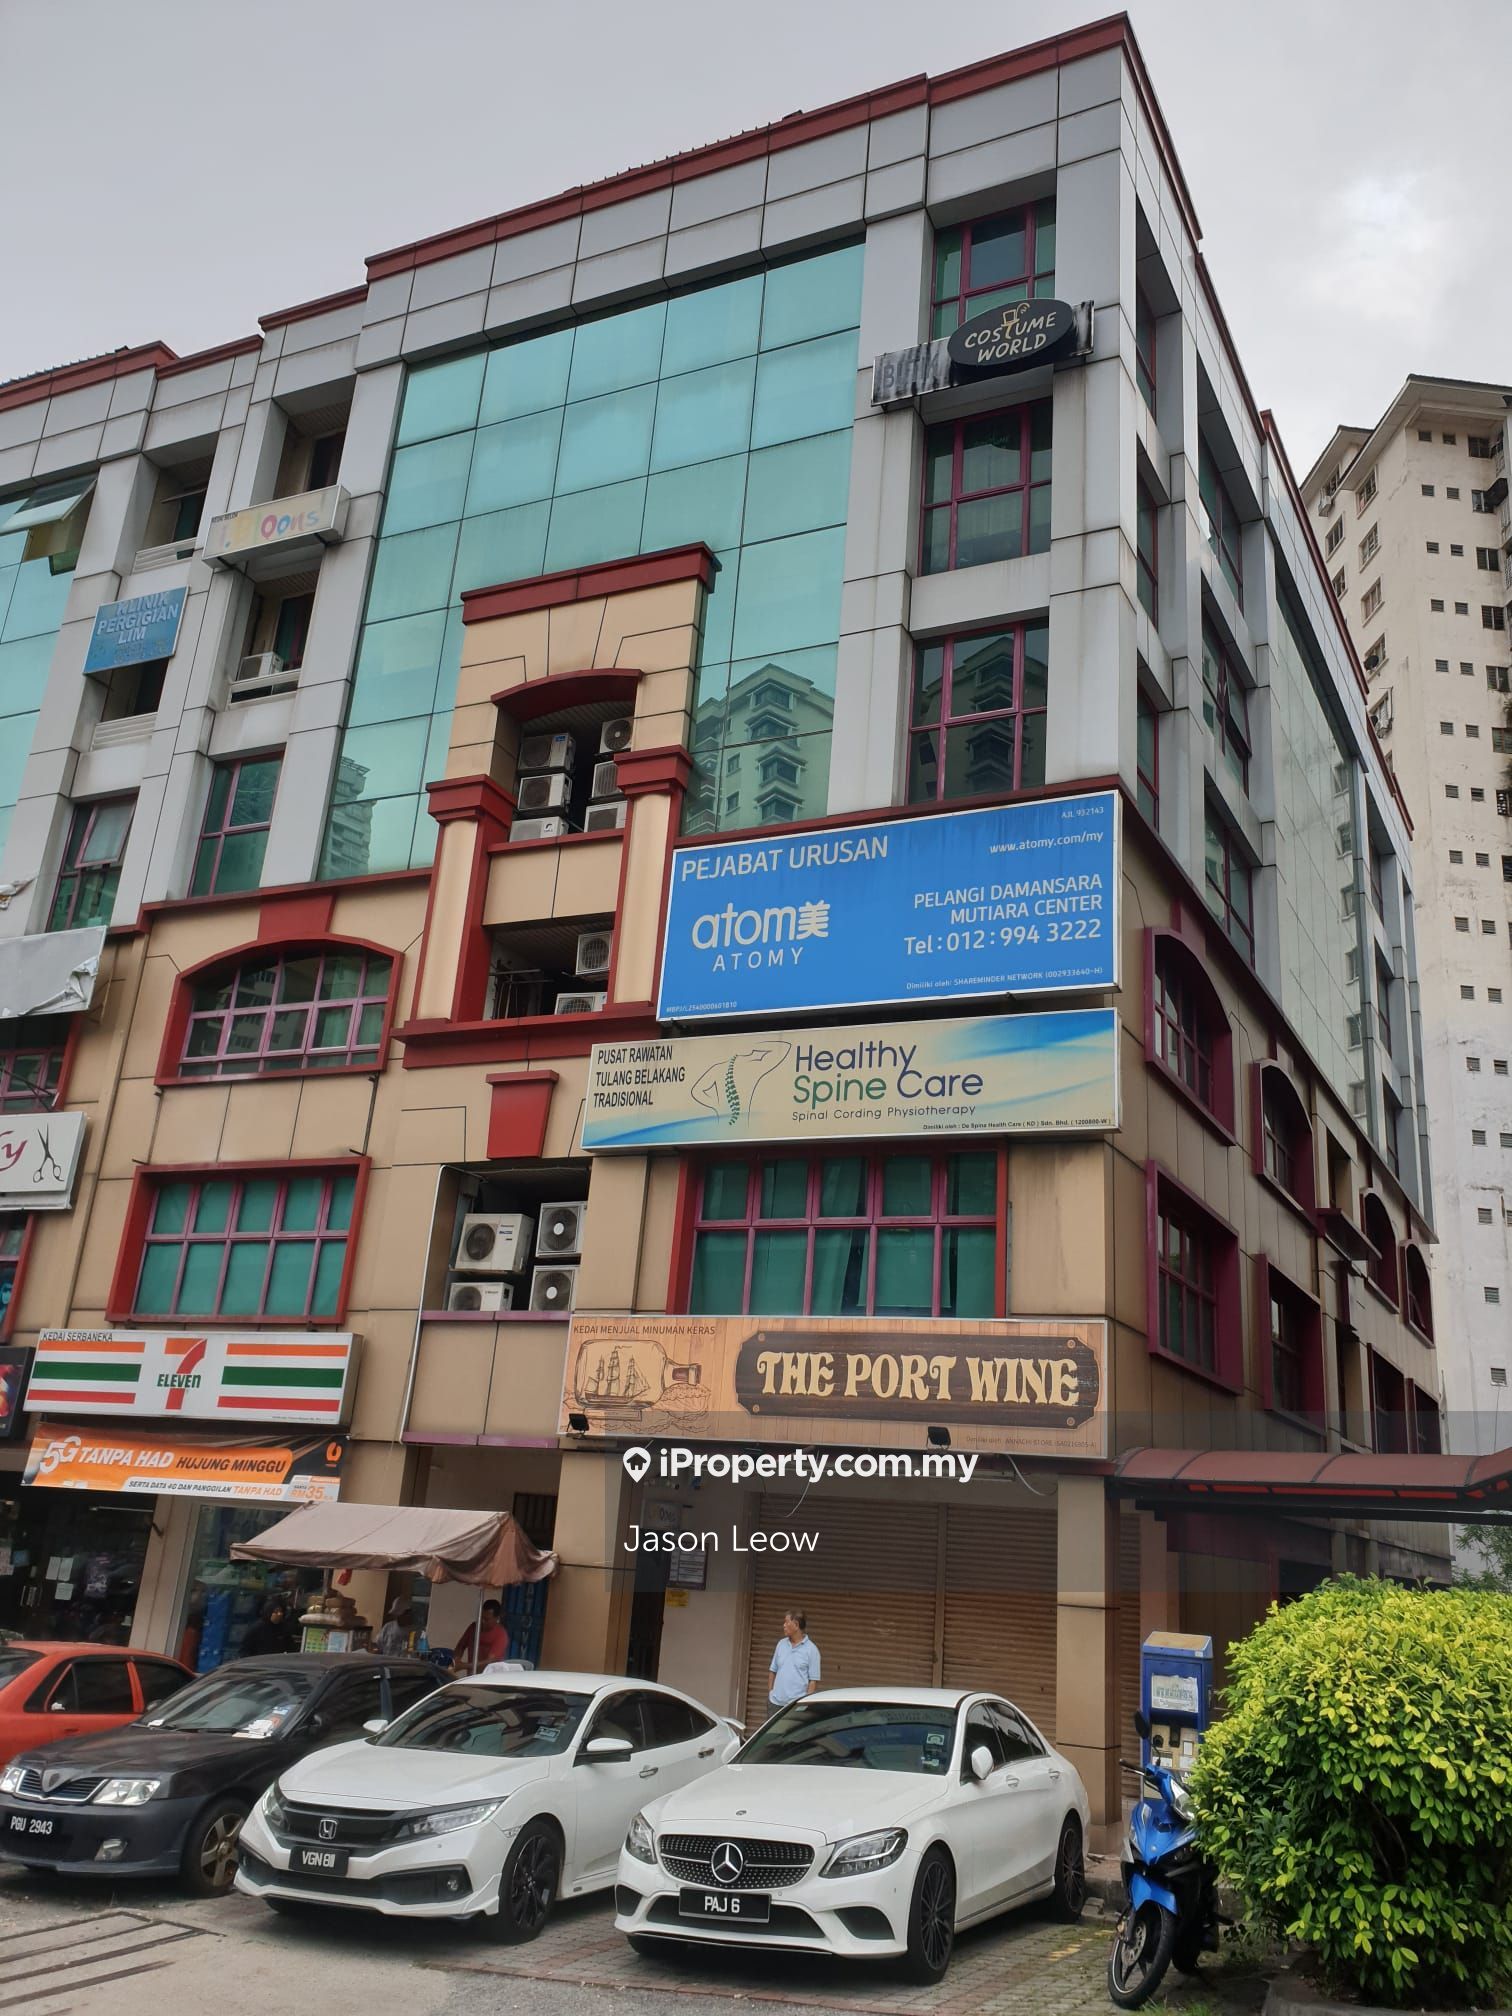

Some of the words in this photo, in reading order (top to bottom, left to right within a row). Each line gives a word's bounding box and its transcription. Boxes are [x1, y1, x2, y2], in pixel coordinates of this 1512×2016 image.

[964, 311, 1057, 348] COSTUME
[977, 333, 1047, 364] WORLD
[97, 603, 179, 635] PERGIGIAN
[118, 627, 146, 644] LIM
[989, 831, 1103, 854] www.atomy.com/my
[681, 849, 783, 882] PEJABAT
[789, 836, 888, 869] URUSAN
[914, 887, 984, 909] PELANGI
[990, 873, 1103, 900] DAMANSARA
[950, 902, 1029, 925] MUTIARA
[1034, 894, 1103, 916] CENTER
[1046, 918, 1101, 943] 3222
[712, 947, 804, 972] ATOMY
[1007, 972, 1043, 981] NETWORK
[597, 1048, 627, 1064] PUSAT
[629, 1045, 673, 1062] RAWATAN
[795, 1040, 916, 1073] Healthy
[595, 1069, 632, 1087] TULANG
[634, 1066, 685, 1085] BELAKANG
[593, 1090, 653, 1108] TRADISIONAL
[793, 1072, 887, 1109] Spine
[896, 1069, 983, 1098] Care
[792, 1110, 828, 1122] Spinal
[833, 1107, 882, 1121] Cording
[887, 1105, 976, 1118] Physiotherapy
[43, 1332, 66, 1341] KEDAI
[66, 1332, 113, 1342] SERBANEKA
[573, 1325, 599, 1334] KEDAI
[600, 1325, 640, 1334] MENJUAL
[642, 1325, 685, 1335] MINUMAN
[687, 1326, 716, 1335] KERAS
[165, 1338, 208, 1410] 7
[756, 1350, 834, 1397] THE
[844, 1352, 957, 1401] PORT
[965, 1356, 1080, 1407] WINE
[40, 1436, 81, 1474] 5G
[79, 1447, 133, 1466] TANPA
[134, 1450, 174, 1468] HAD
[176, 1456, 230, 1470] HUJUNG
[230, 1459, 287, 1473] MINGGU
[128, 1480, 149, 1488] SERTA
[192, 1484, 232, 1493] PANGGILAN
[233, 1486, 261, 1495] TANPA
[263, 1487, 283, 1496] HAD
[10, 1815, 27, 1831] PGU
[29, 1819, 53, 1835] 2943
[302, 1850, 323, 1866] VGN
[704, 1895, 728, 1912] PAJ
[731, 1898, 740, 1914] 6
